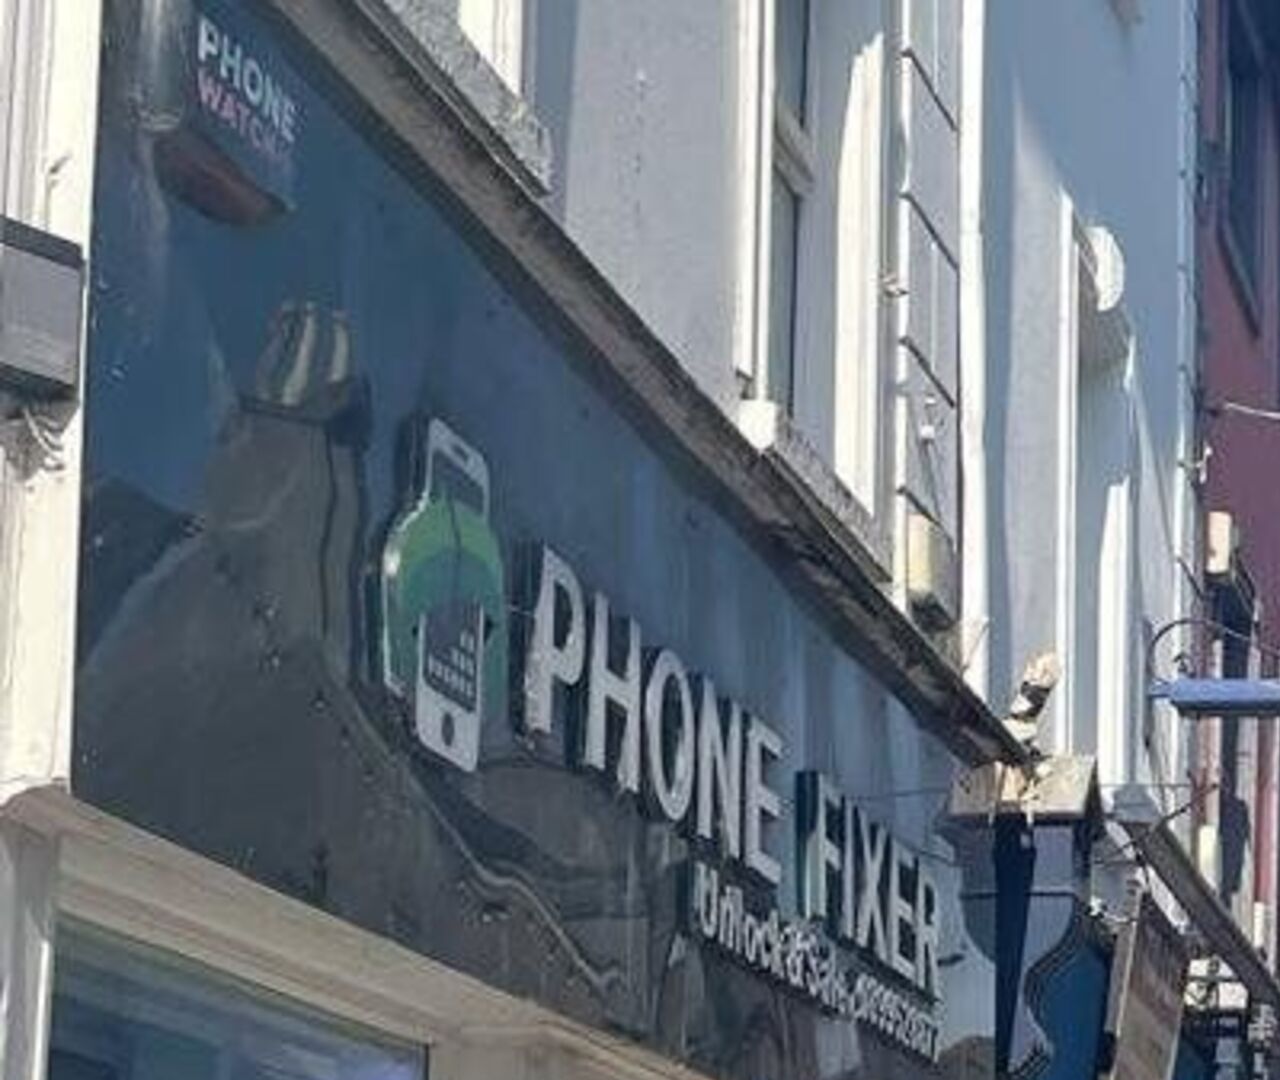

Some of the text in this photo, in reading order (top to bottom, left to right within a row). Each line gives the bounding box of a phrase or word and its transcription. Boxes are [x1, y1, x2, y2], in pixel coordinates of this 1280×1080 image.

[199, 17, 297, 143] PHONE
[523, 545, 942, 1003] PHONE FIXER
